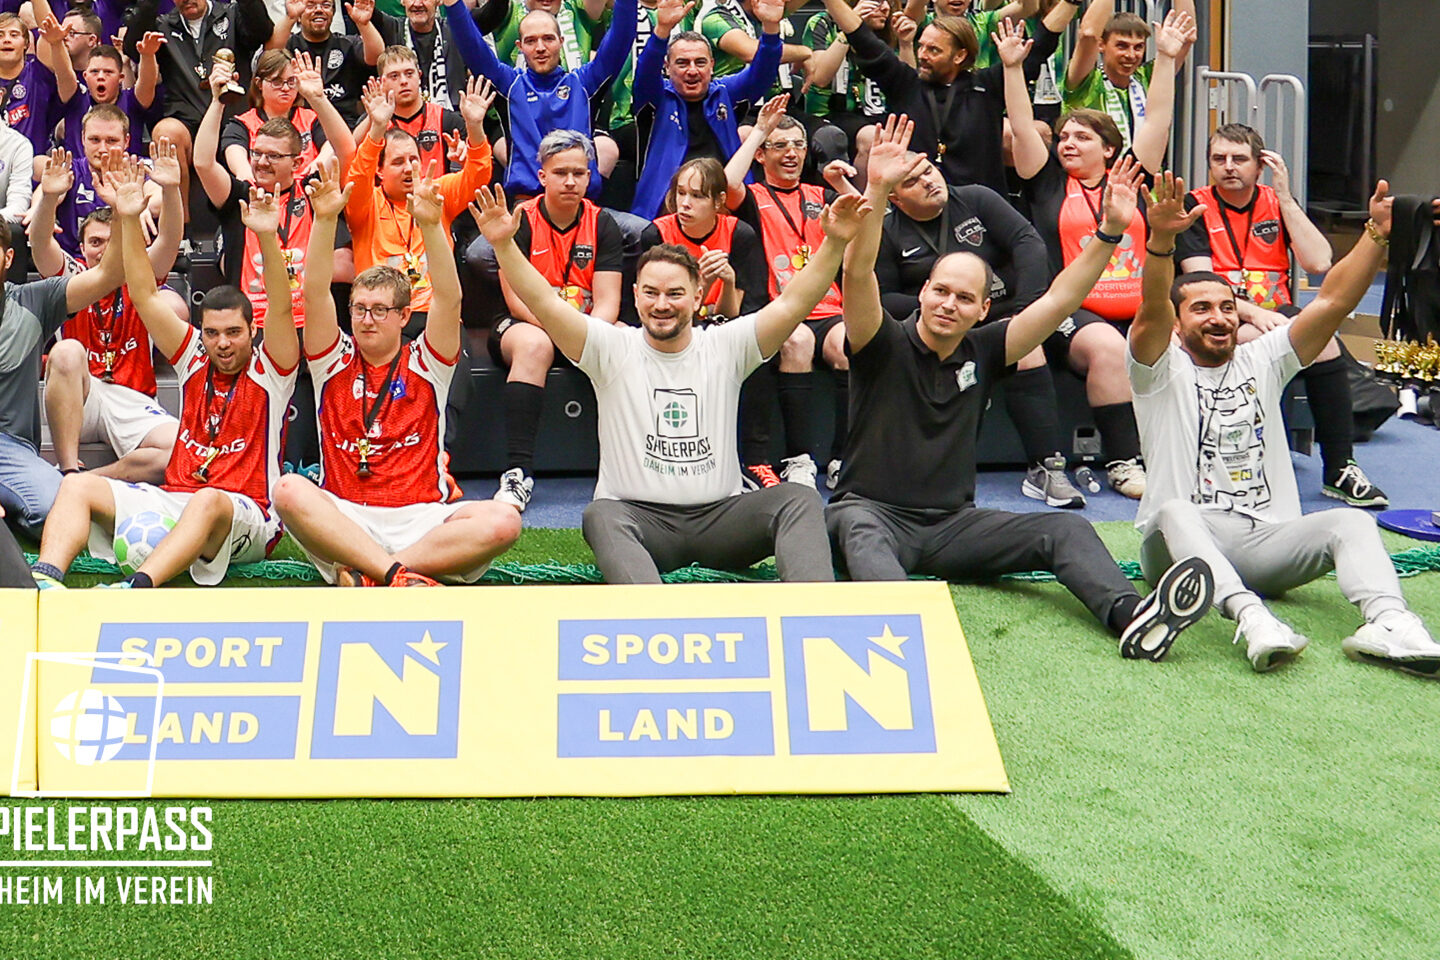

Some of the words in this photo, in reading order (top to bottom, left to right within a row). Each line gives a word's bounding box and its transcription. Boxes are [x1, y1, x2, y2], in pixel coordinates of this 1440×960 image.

[384, 431, 421, 450] AG
[118, 637, 284, 668] SPORT
[583, 632, 744, 665] SPORT
[333, 643, 440, 737] N
[801, 637, 913, 731] N
[122, 712, 260, 744] LAND
[598, 709, 735, 741] LAND
